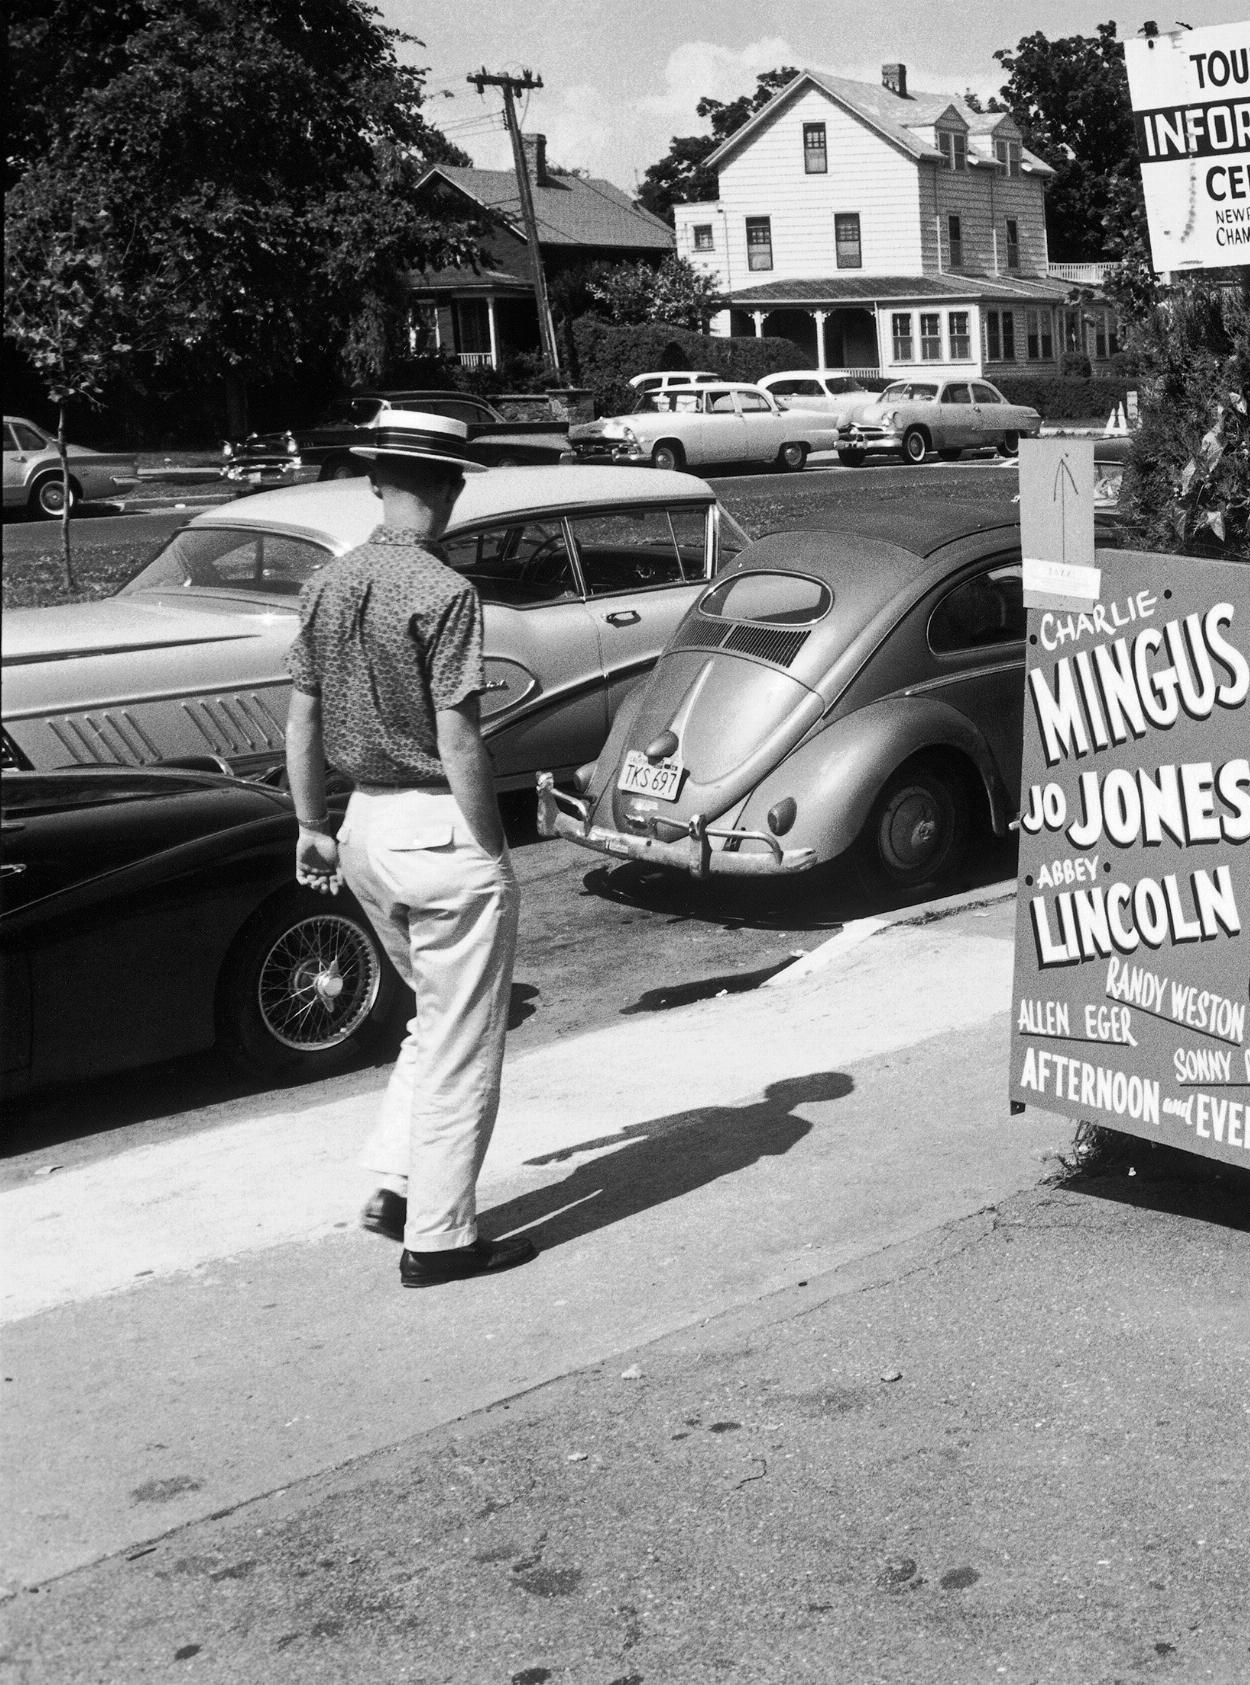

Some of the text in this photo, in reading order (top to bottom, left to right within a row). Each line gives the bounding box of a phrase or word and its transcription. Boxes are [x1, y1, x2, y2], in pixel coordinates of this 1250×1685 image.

[1040, 590, 1157, 650] CHARLIE
[1029, 602, 1250, 768] MINGUS
[625, 764, 677, 793] TKS 697
[1022, 783, 1066, 834] JO
[1037, 855, 1099, 889] ABBEY
[1030, 865, 1241, 969] LINCOLN
[1018, 999, 1138, 1047] ALLEN EGER
[1105, 956, 1245, 1043] RANDY WESTON
[1020, 1047, 1160, 1125] AFTERNOON
[1163, 1095, 1194, 1125] and
[1174, 1048, 1231, 1082] SONNY
